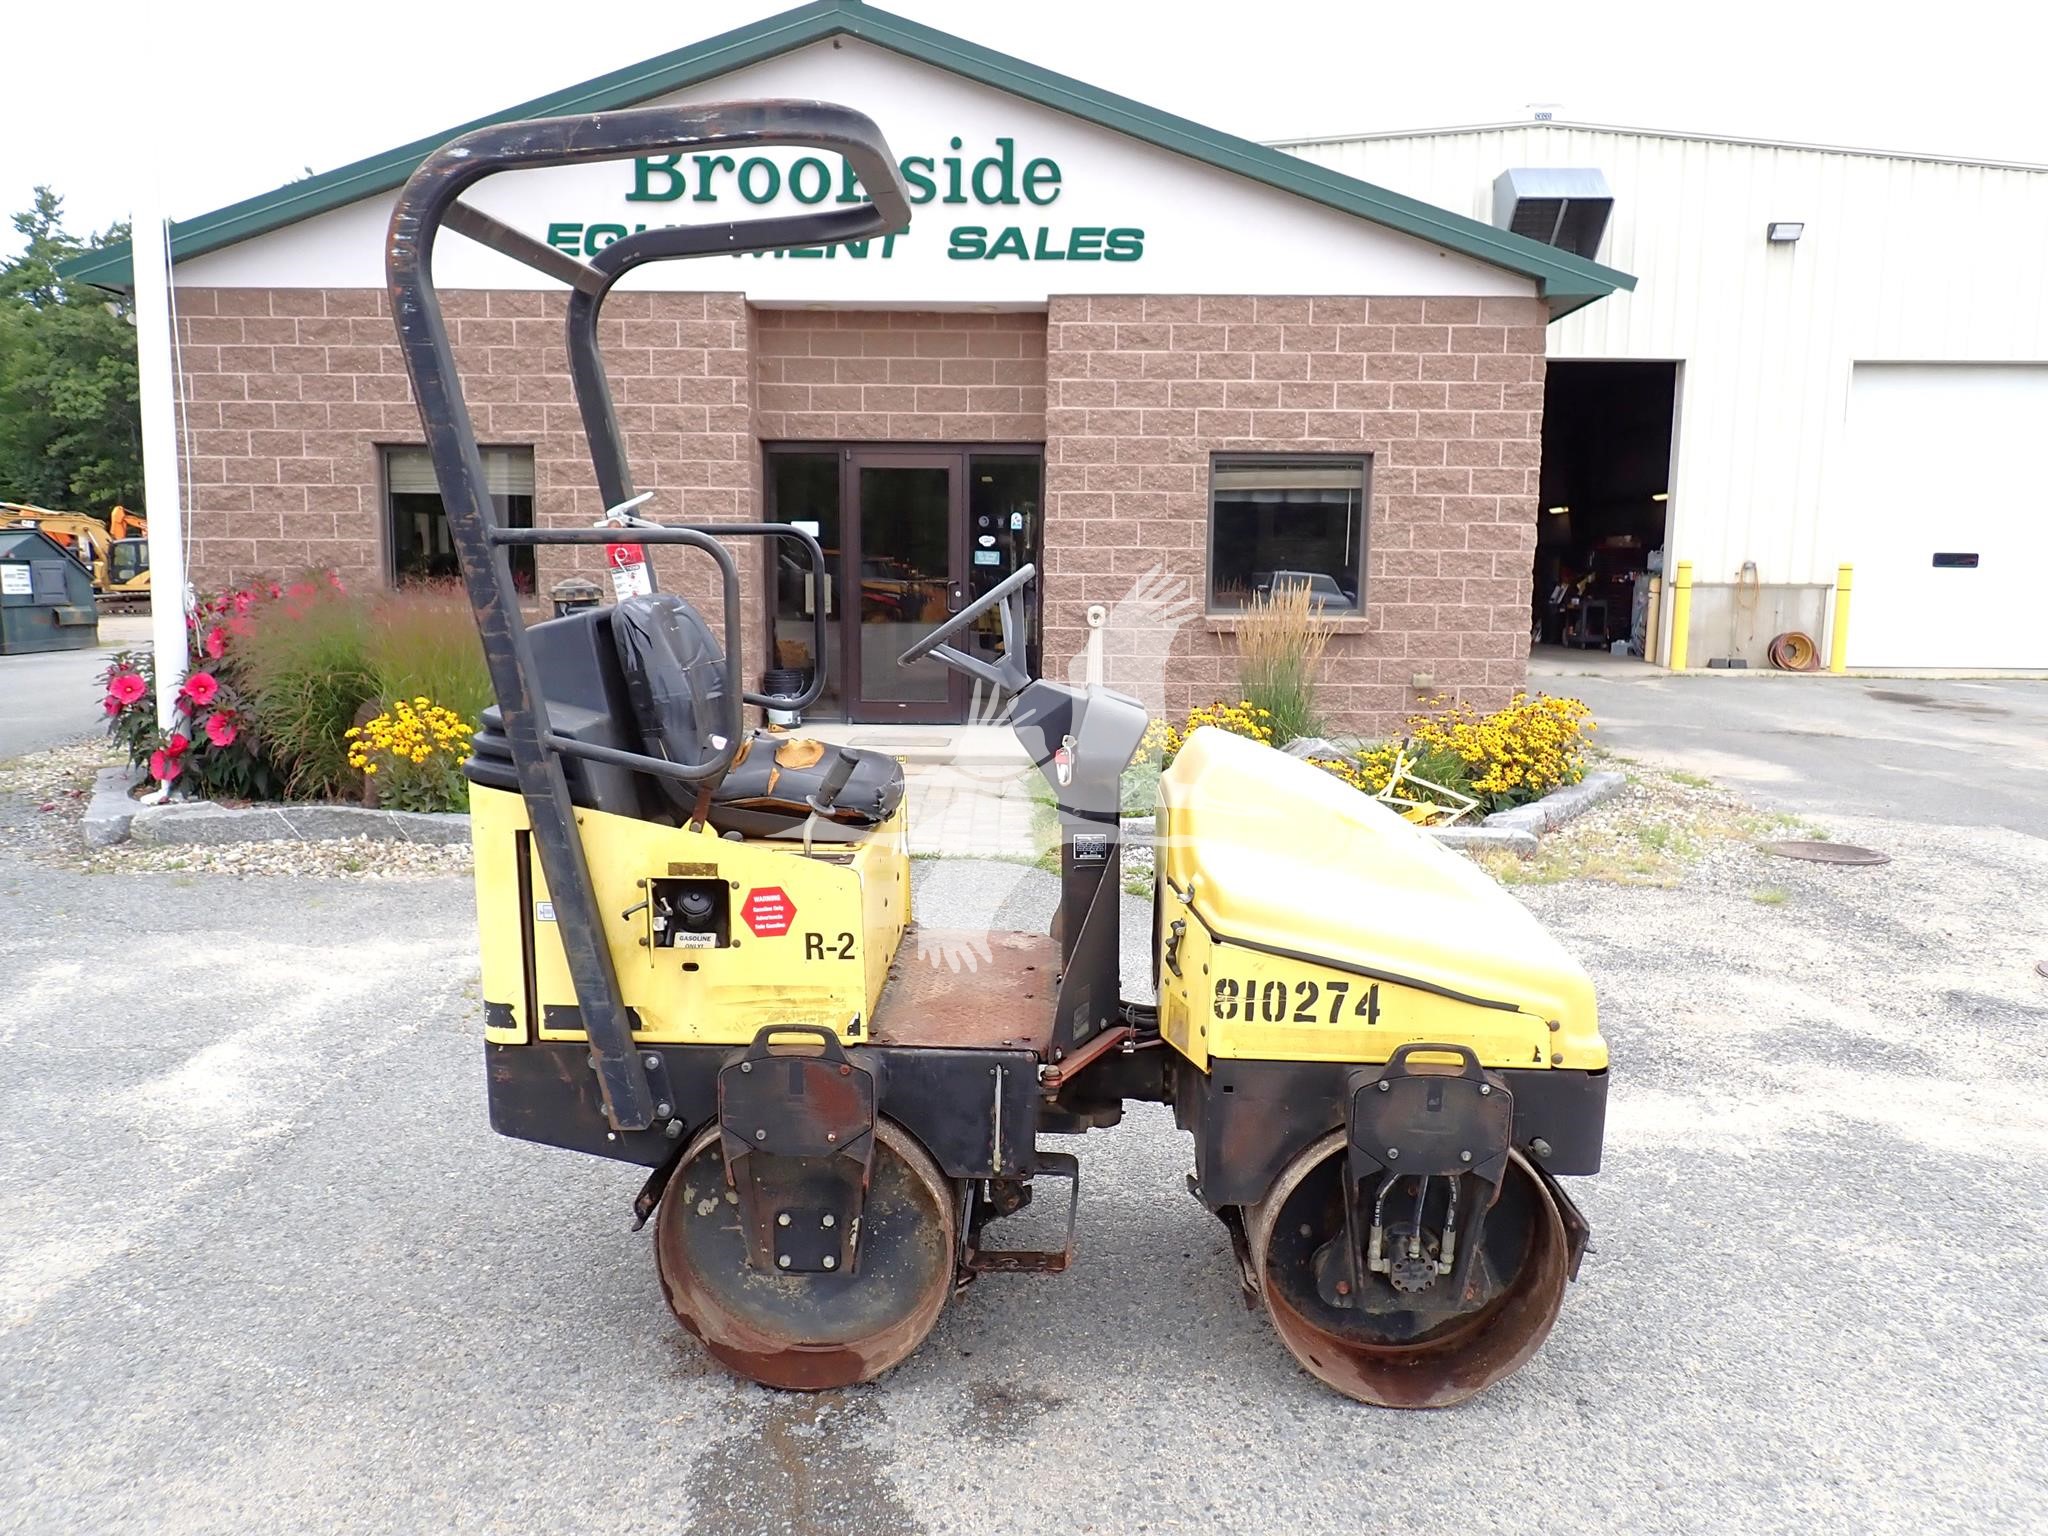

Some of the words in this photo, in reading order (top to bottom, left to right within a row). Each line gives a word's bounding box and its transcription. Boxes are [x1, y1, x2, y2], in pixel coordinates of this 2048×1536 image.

[947, 225, 1146, 262] SALES
[805, 932, 856, 960] R-2
[1213, 978, 1381, 1025] 810274
